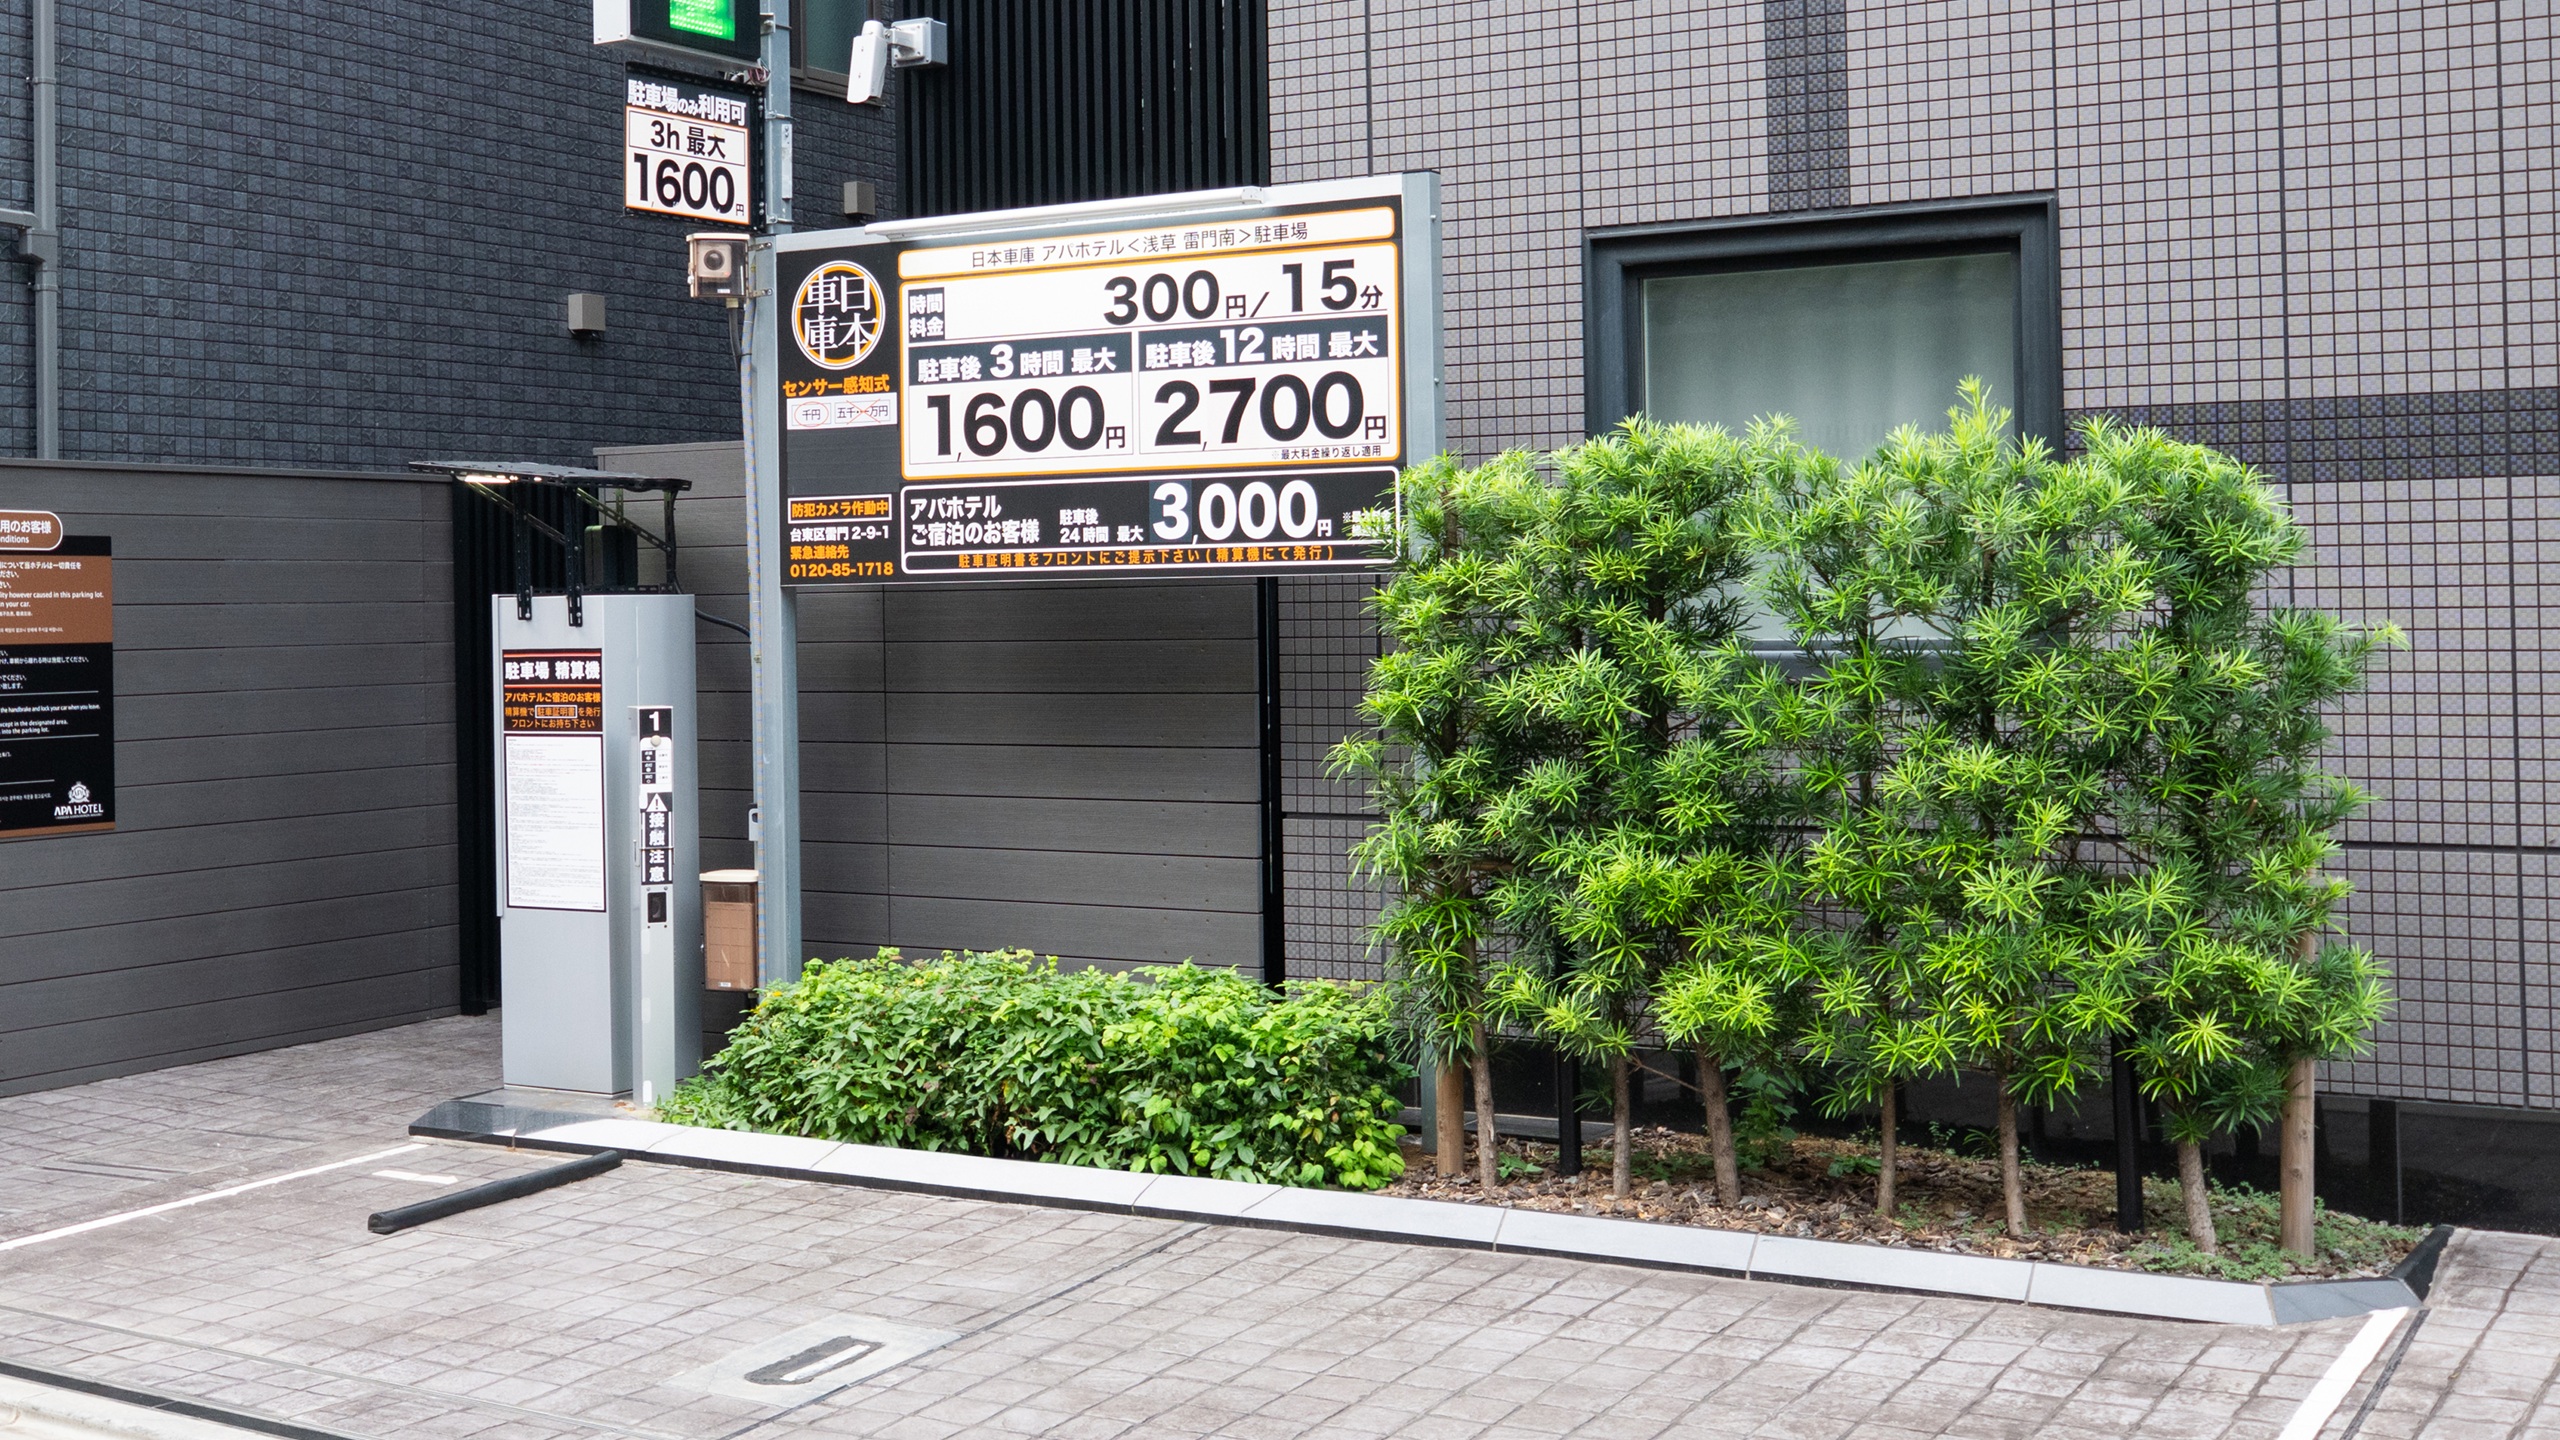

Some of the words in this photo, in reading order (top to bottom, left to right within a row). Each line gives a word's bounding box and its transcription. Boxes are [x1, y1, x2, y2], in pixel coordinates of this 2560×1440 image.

[627, 79, 747, 126] 駐車場のみ利用可
[650, 120, 679, 150] 3h
[687, 126, 726, 159] 最大
[971, 246, 1035, 269] 日本車庫
[909, 292, 944, 315] 時間
[909, 316, 944, 338] 料金
[1328, 330, 1379, 358] 最大
[917, 355, 982, 384] 駐車後
[1071, 347, 1117, 373] 最大
[783, 374, 890, 398] センサー感知式
[802, 409, 820, 421] 千円
[791, 500, 888, 519] 防犯カメラ作動中
[910, 495, 1002, 520] アパホテル
[1059, 508, 1099, 526] 駐車後
[790, 526, 850, 543] 台東区雷門
[851, 526, 889, 541] 2-9-1
[911, 519, 1040, 546] ご宿泊のお客様
[1116, 525, 1144, 543] 最大
[790, 545, 850, 560] 緊急連絡先
[790, 561, 894, 578] 0120-85-1718
[72, 591, 94, 599] parking
[505, 661, 550, 680] 駐車場
[555, 661, 600, 680] 精算機
[648, 711, 660, 732] 1
[54, 806, 73, 817] APA
[74, 803, 104, 815] HOTEL
